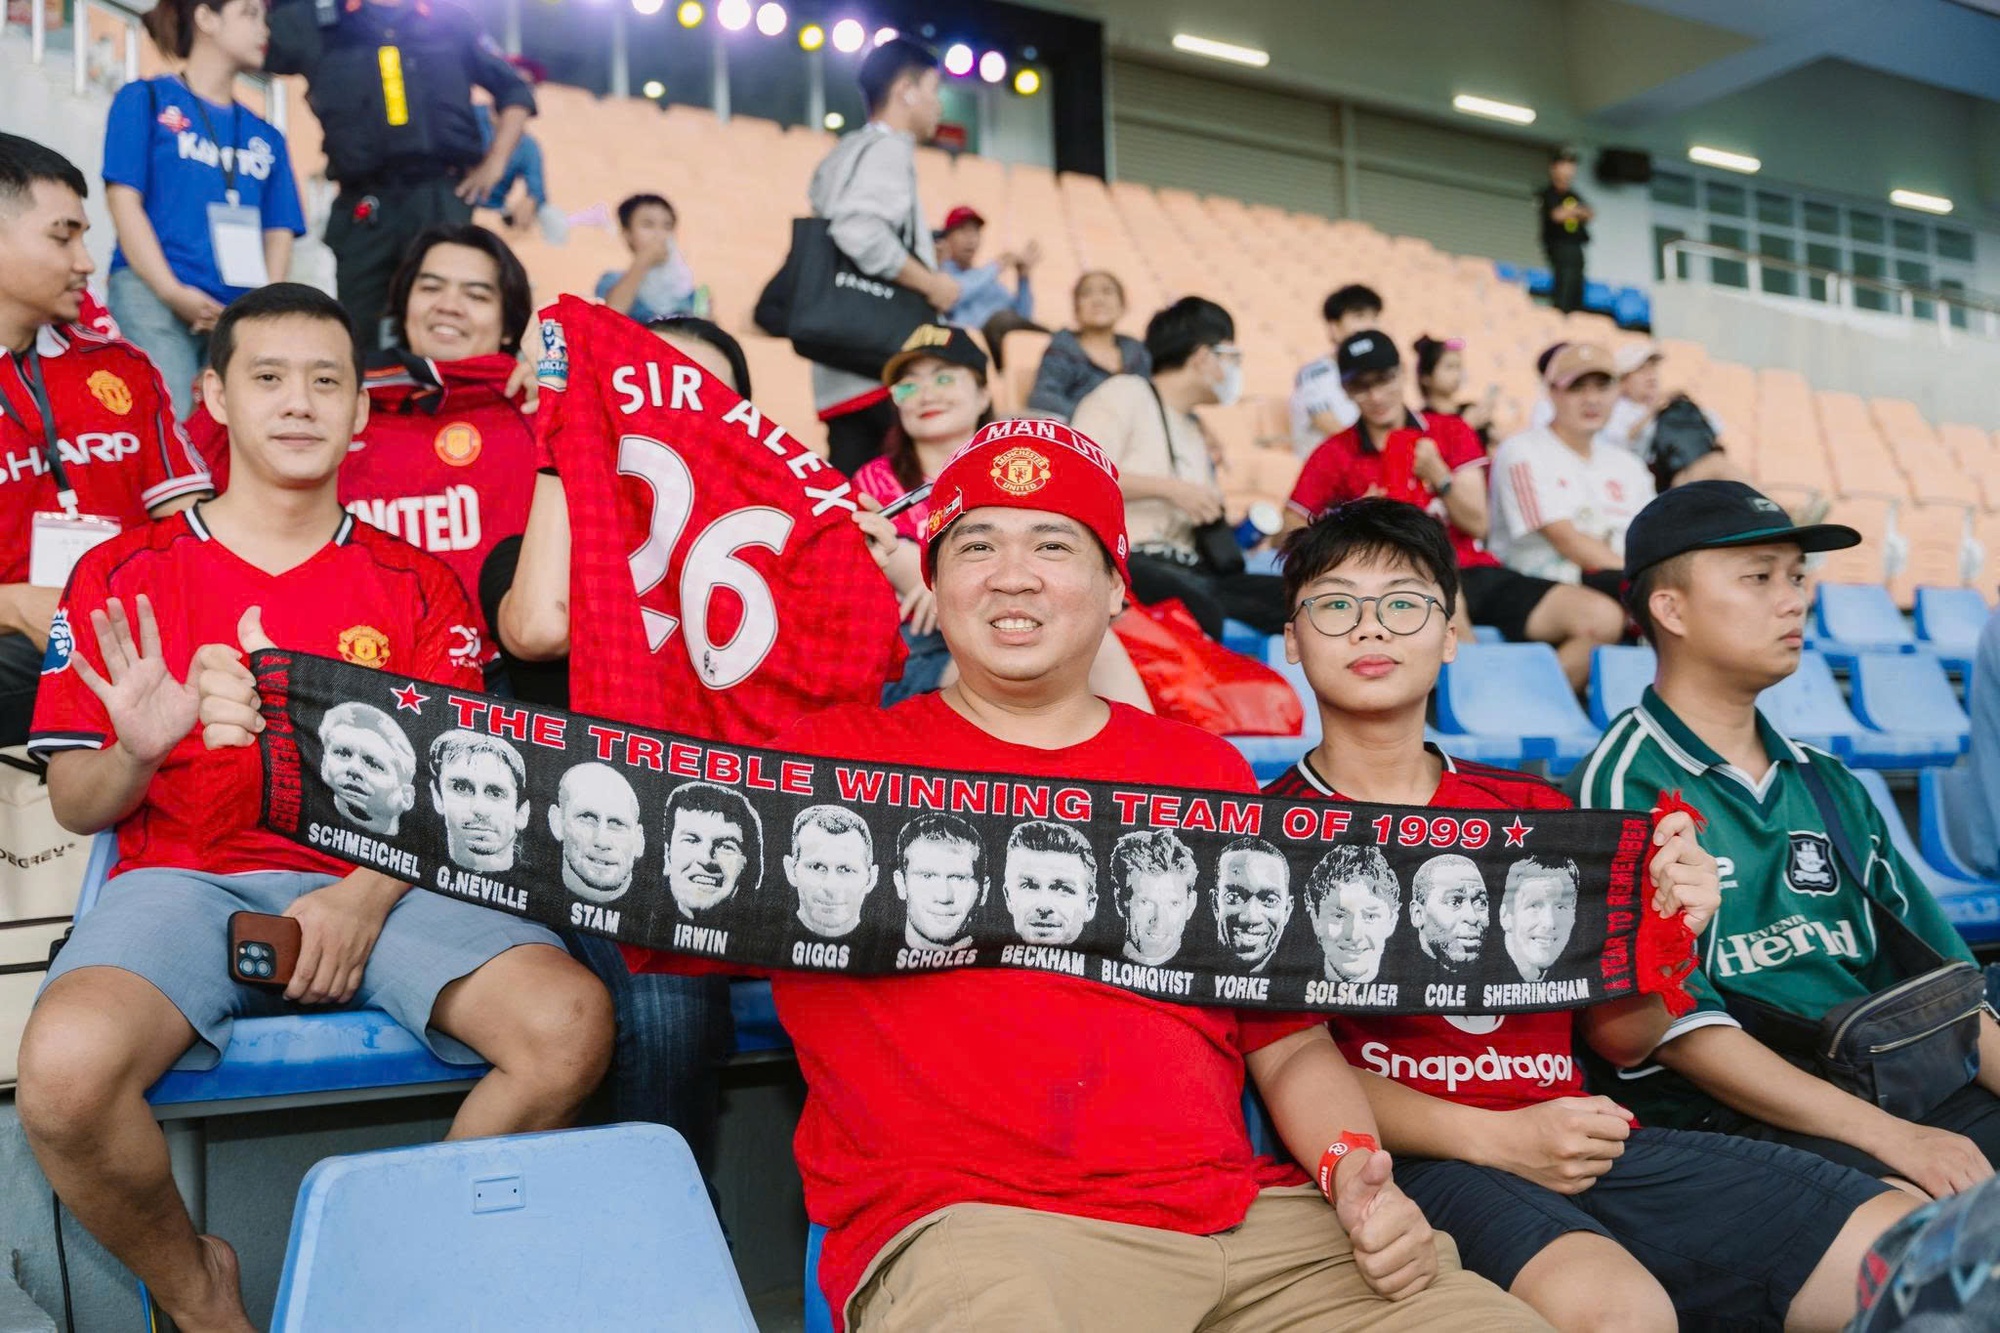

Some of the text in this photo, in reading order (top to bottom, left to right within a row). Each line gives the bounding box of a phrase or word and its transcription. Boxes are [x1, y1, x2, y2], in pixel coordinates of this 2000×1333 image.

[612, 361, 705, 415] SIR
[721, 399, 859, 518] ALEX
[985, 421, 1057, 441] MAN
[995, 448, 1046, 469] MANCHESTER
[1002, 481, 1038, 492] UNITED
[345, 484, 482, 552] NITED
[617, 434, 796, 690] 26
[448, 694, 1492, 849] THE TREBLE WINNING TEAM OF 1999
[307, 821, 422, 879] SCHMEICHEL
[436, 866, 529, 911] G.NEVILLE
[1600, 818, 1648, 991] A YEAR TO REMEMBER
[570, 901, 620, 934] STAM
[673, 923, 729, 955] IRWIN
[792, 940, 851, 969] GIGGS
[1717, 919, 1862, 977] Herld
[895, 947, 978, 970] SCHOLES
[1000, 944, 1086, 977] BECKHAM
[1101, 959, 1194, 996] BLOMQVIST
[1214, 975, 1270, 1001] YORKE
[1304, 980, 1399, 1007] SOLSKJAER
[1482, 977, 1591, 1008] SHERRINGHAM
[1424, 983, 1467, 1007] COLE
